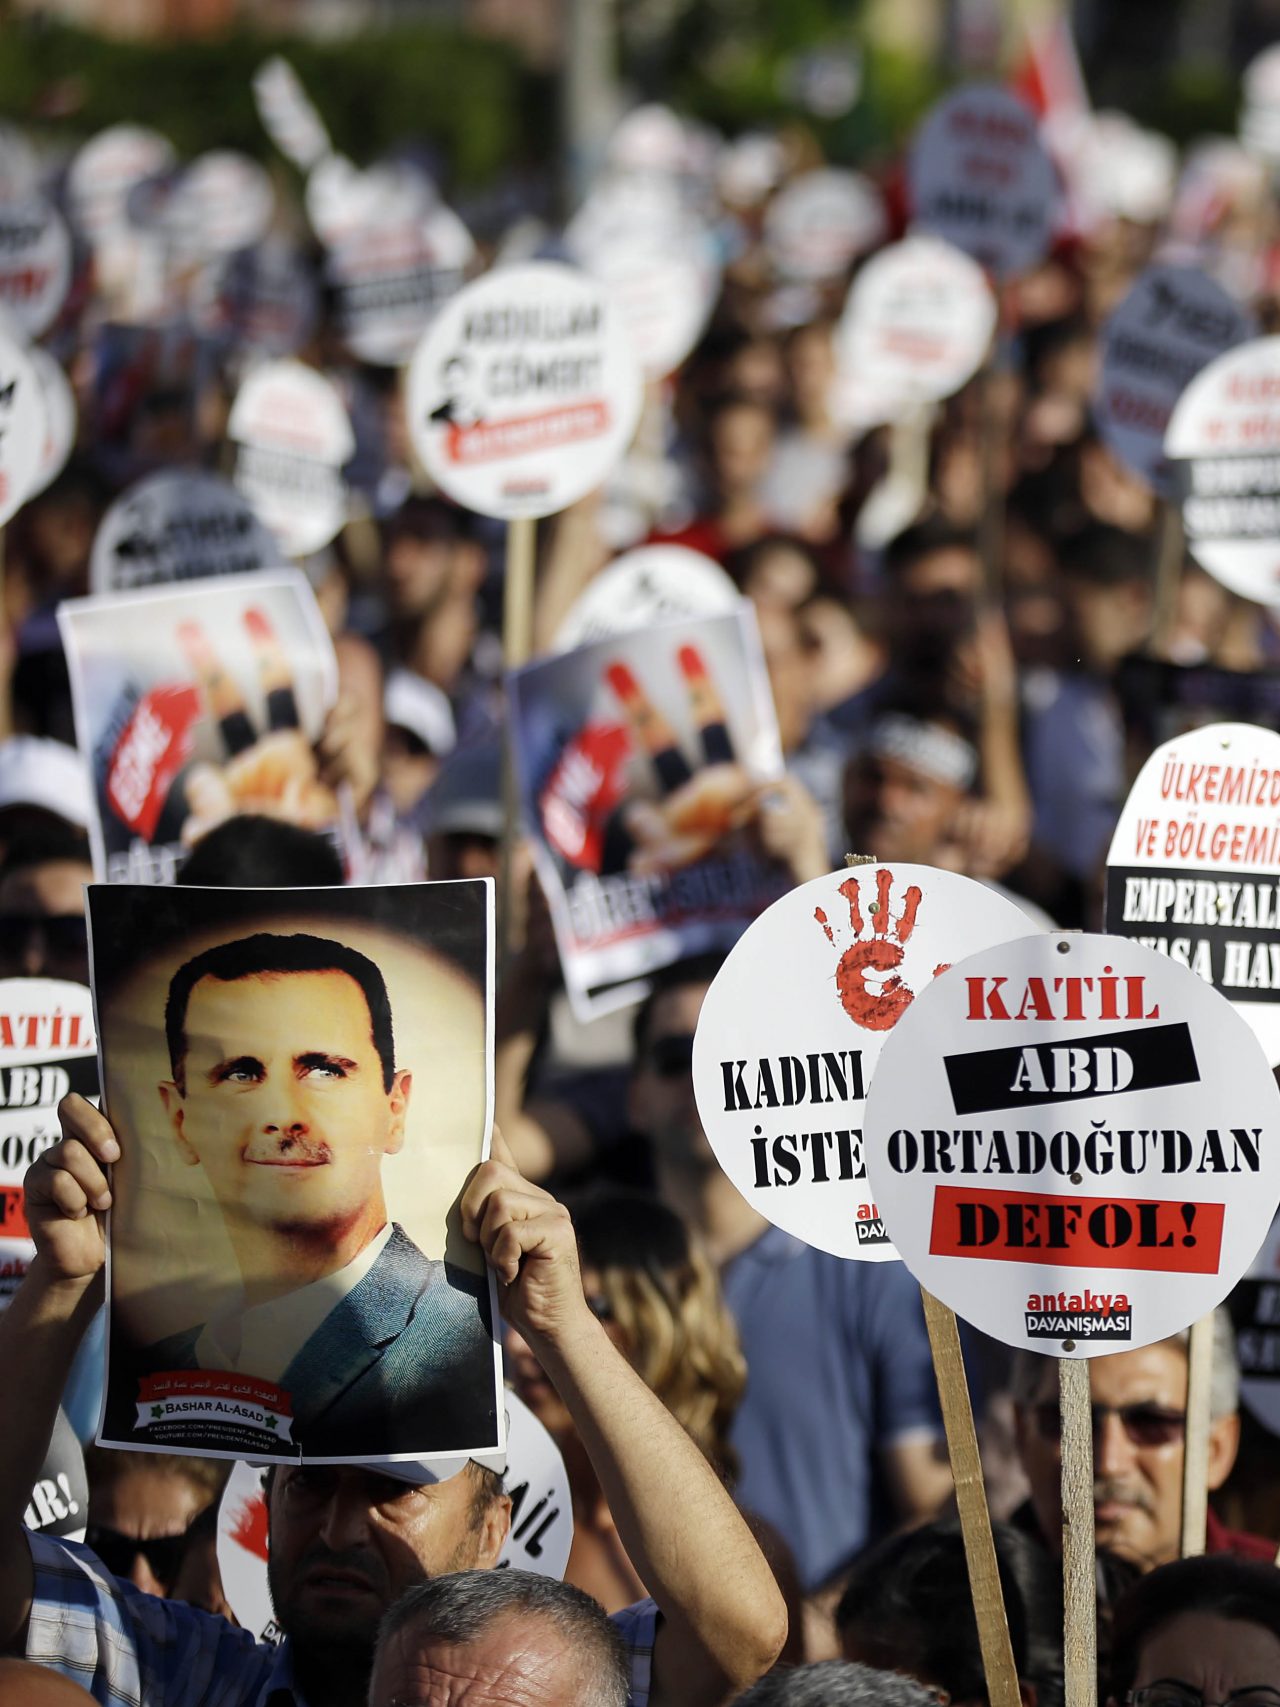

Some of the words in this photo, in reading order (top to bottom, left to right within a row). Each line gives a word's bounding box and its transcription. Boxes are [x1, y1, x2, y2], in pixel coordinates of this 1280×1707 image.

[1134, 818, 1160, 858] VE
[964, 964, 1160, 1022] KATİL
[720, 1050, 872, 1112] KADINL
[1010, 1047, 1135, 1093] ABD
[887, 1120, 1264, 1177] ORTADOĞU'DAN
[956, 1202, 1199, 1250] DEFOL!
[1027, 1289, 1129, 1318] antakya
[1027, 1316, 1130, 1336] DAYANIŞMASI
[165, 1402, 212, 1414] BASHAR
[215, 1401, 264, 1423] AL-ASAD
